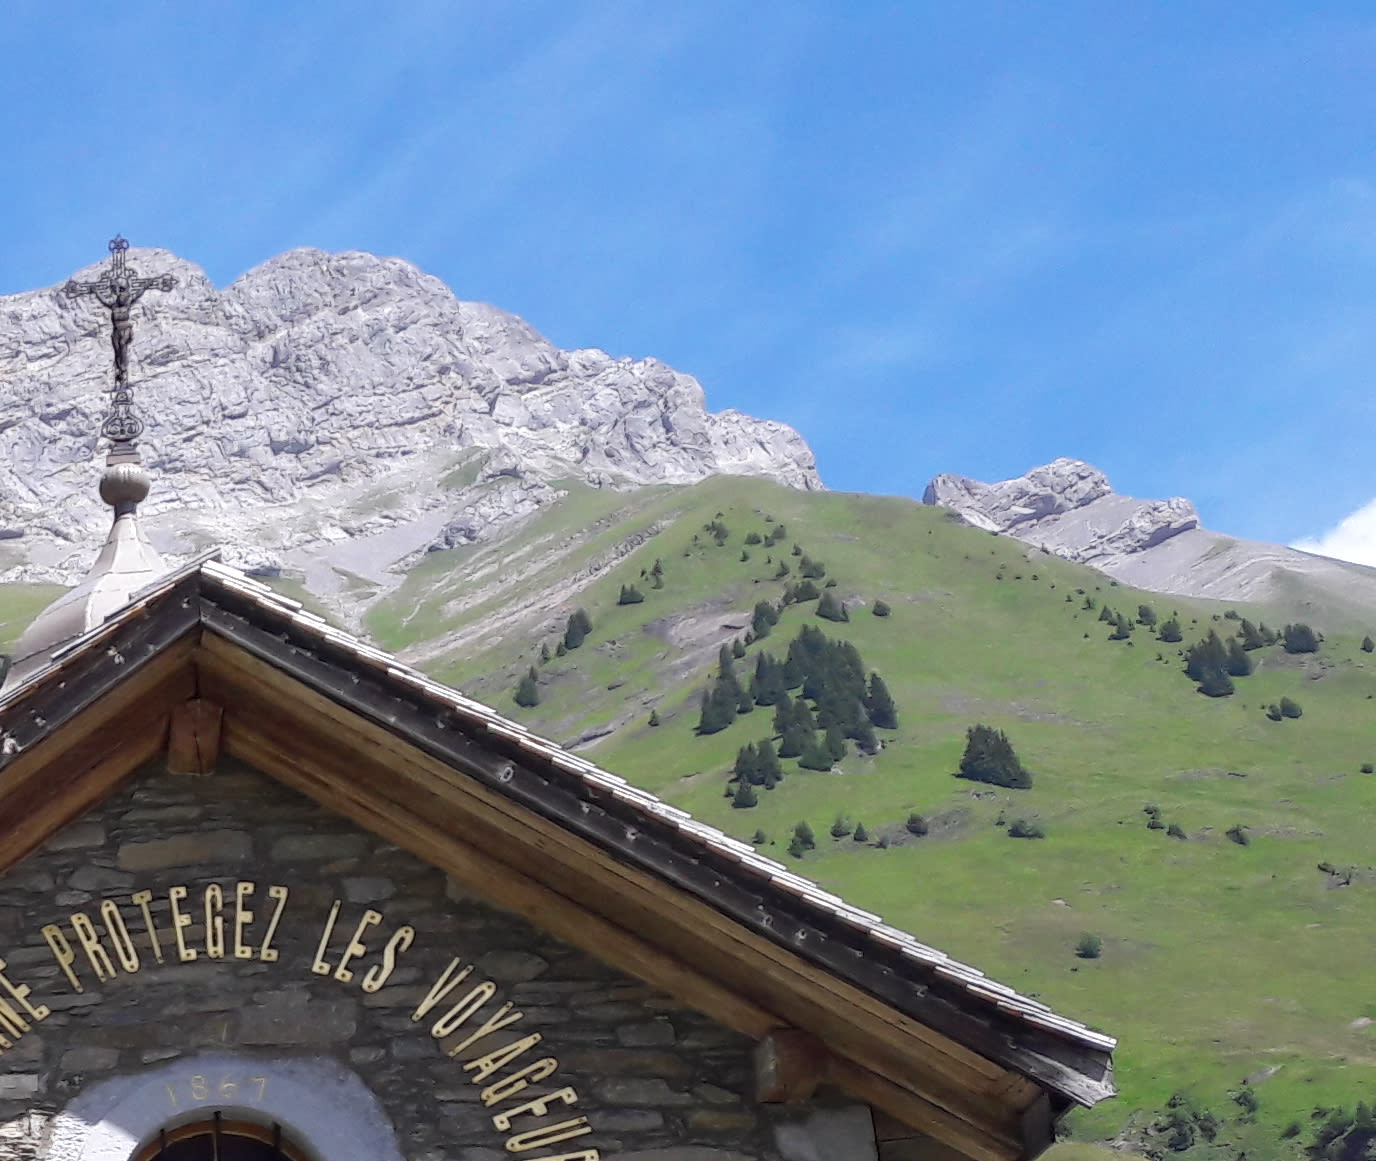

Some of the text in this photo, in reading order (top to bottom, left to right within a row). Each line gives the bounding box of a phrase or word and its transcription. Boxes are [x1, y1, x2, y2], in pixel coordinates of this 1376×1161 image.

[41, 881, 289, 993] PROTEGEZ
[311, 899, 416, 993] LES
[166, 1073, 268, 1106] 1867
